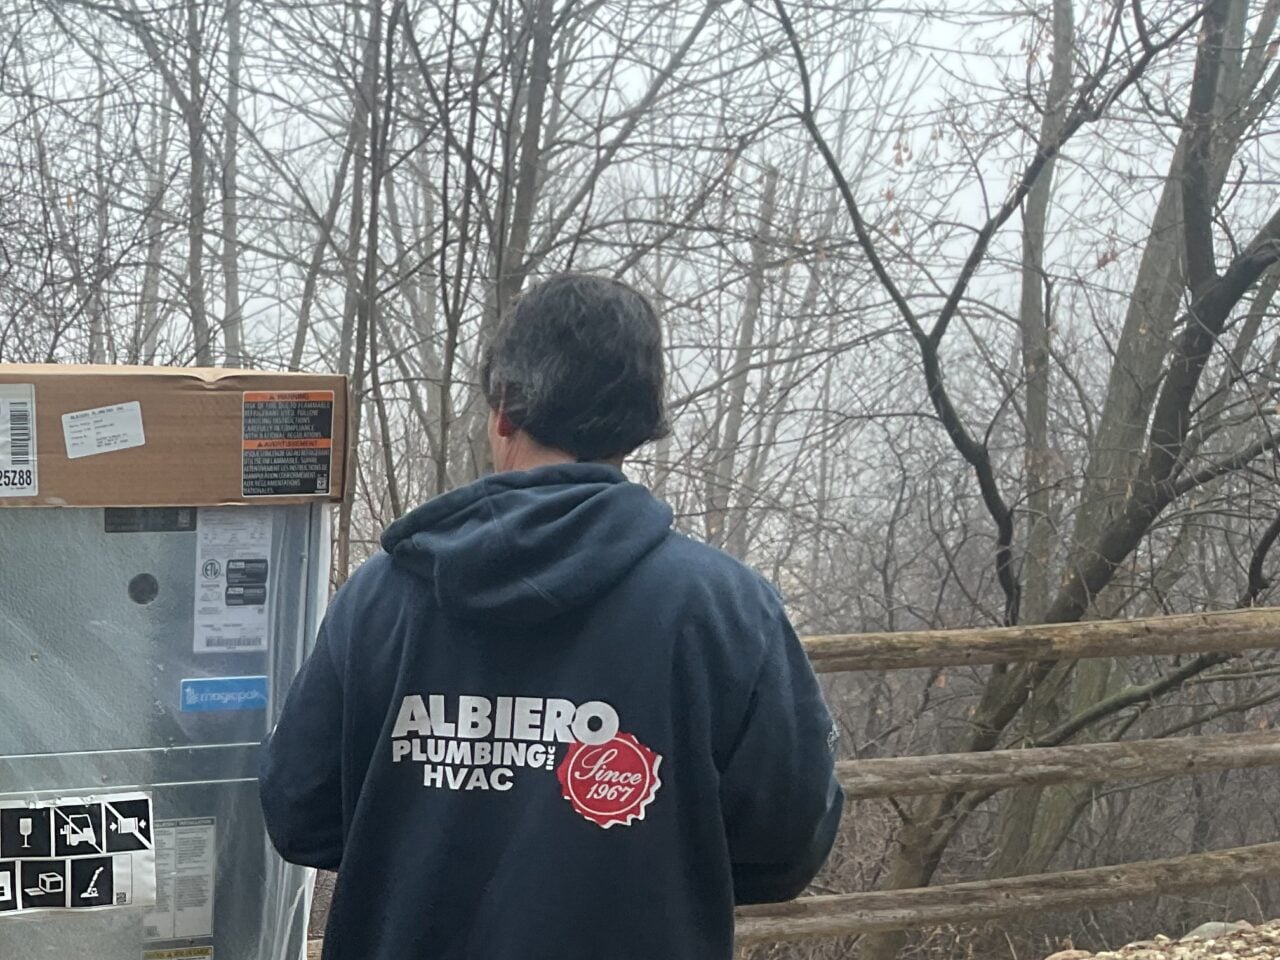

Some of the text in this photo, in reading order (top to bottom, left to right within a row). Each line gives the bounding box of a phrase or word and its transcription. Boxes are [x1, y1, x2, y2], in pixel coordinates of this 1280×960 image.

[391, 694, 619, 745] ALBIERO
[392, 739, 556, 771] PLUMBING INC
[574, 748, 642, 784] Since
[423, 764, 514, 791] HVAC
[586, 783, 635, 802] 1967
